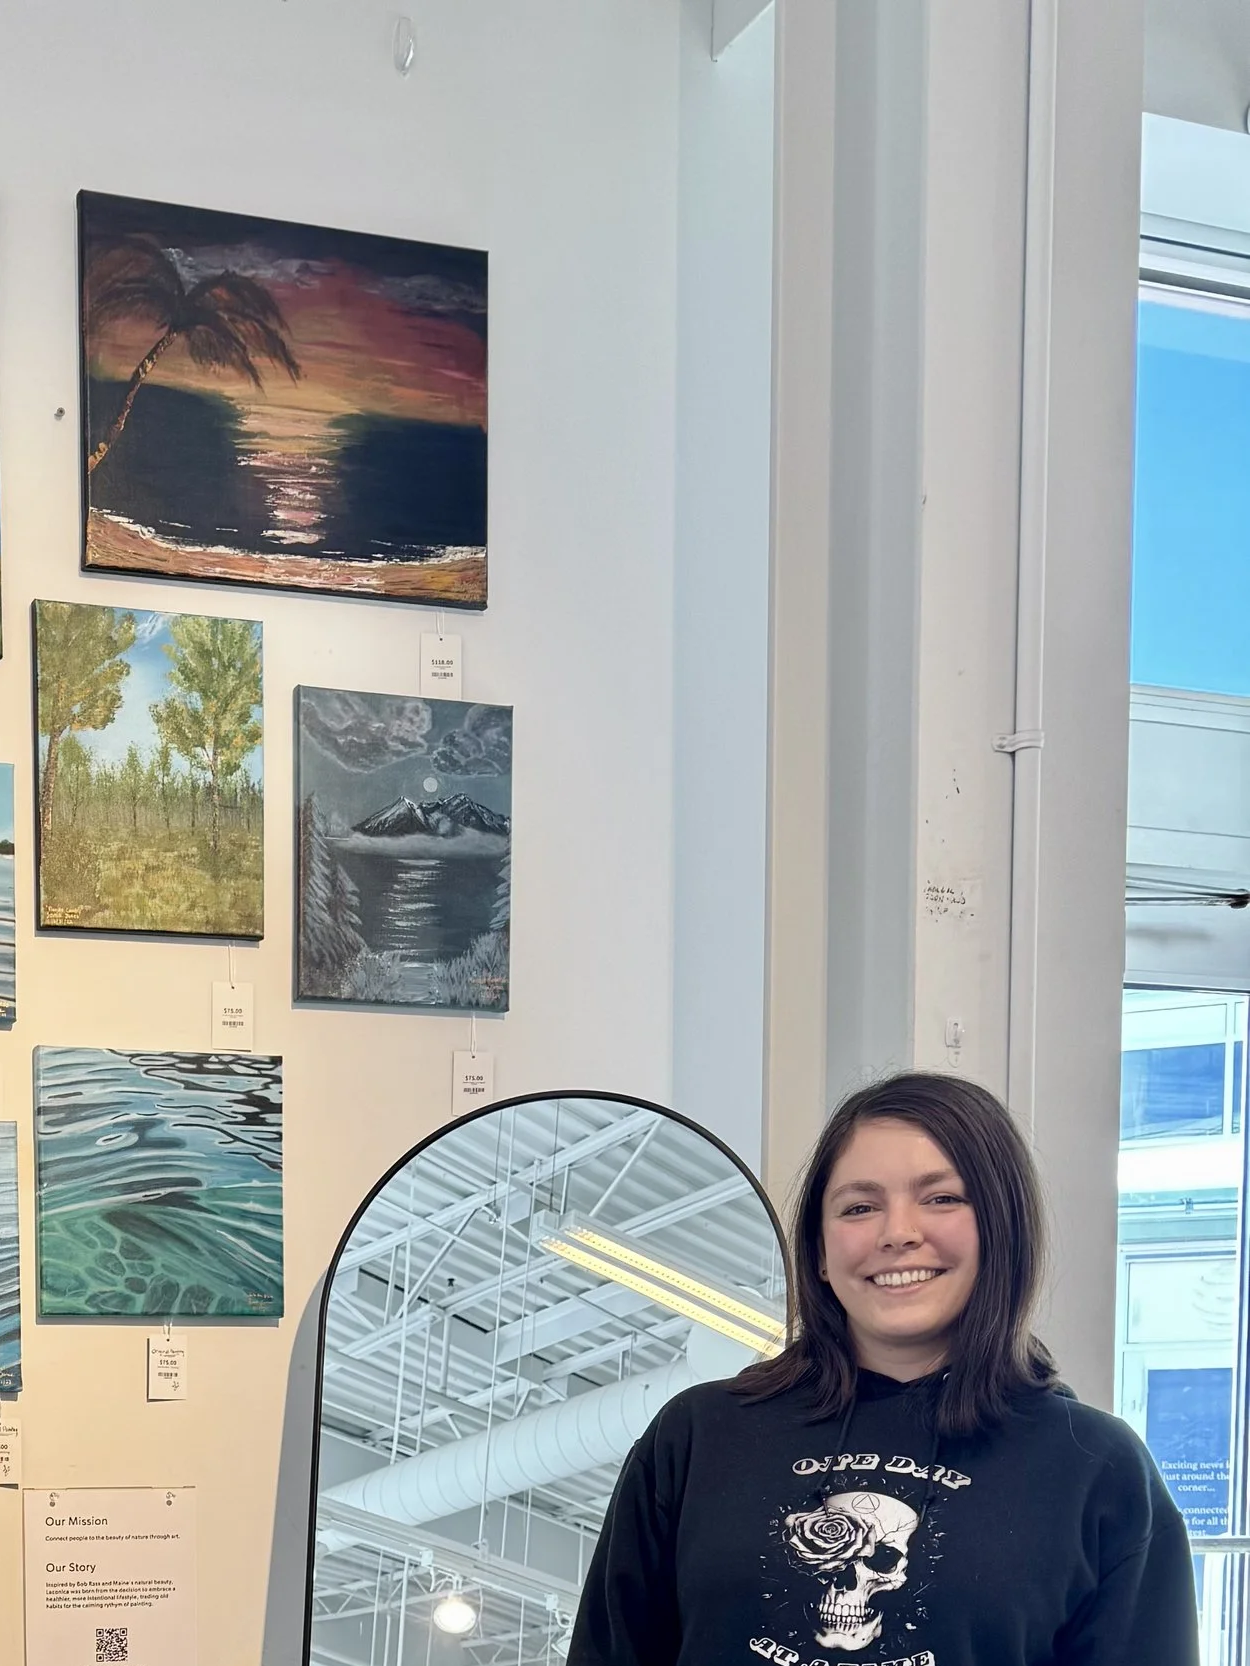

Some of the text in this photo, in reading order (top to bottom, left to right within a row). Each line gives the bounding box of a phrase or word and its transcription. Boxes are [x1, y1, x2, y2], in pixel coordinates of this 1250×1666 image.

[1161, 1460, 1198, 1471] Exciting
[792, 1453, 972, 1490] ONE DAY
[1182, 1471, 1215, 1481] around
[45, 1516, 108, 1527] Our Mission
[1191, 1517, 1206, 1526] for
[1207, 1517, 1218, 1526] all
[46, 1562, 96, 1573] Our Story
